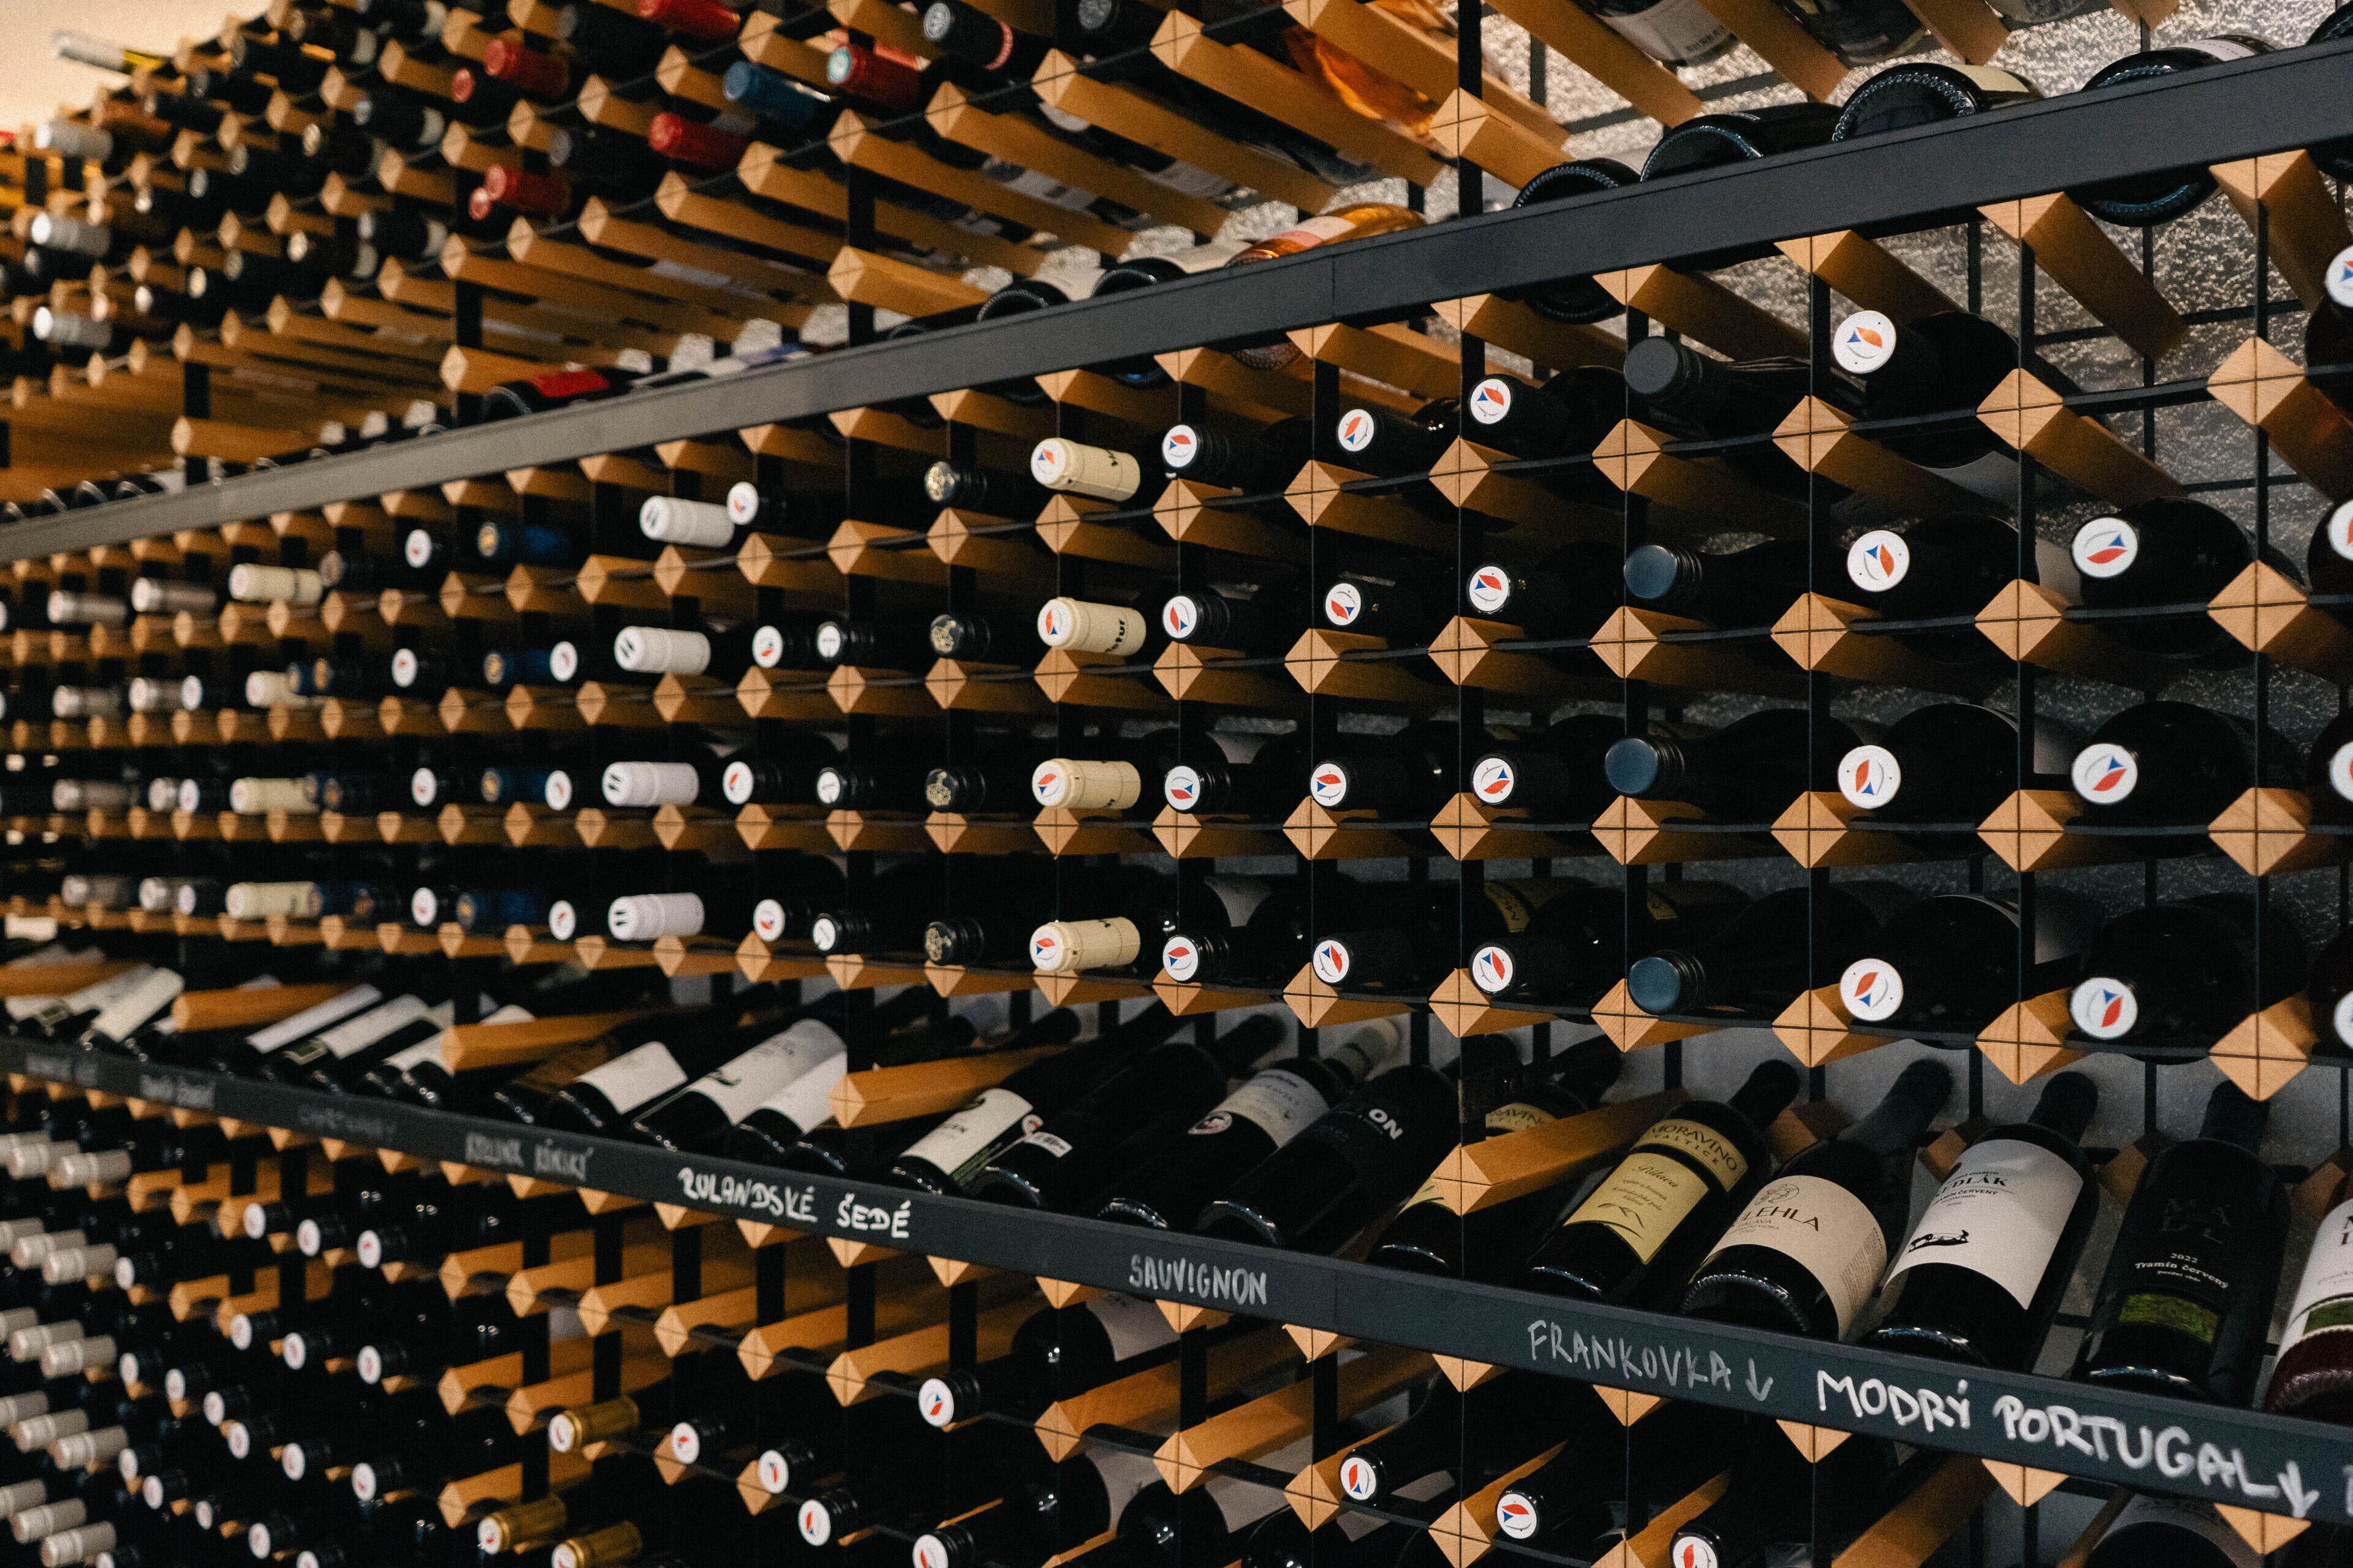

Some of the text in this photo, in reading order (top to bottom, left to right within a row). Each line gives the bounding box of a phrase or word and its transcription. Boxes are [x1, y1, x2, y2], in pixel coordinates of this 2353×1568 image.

[836, 1193, 911, 1239] ŠEDÉ
[1129, 1253, 1268, 1305] SAUVIGNON
[2135, 1261, 2229, 1289] Tramín červený
[2170, 1252, 2199, 1263] 2022
[1527, 1319, 1732, 1392] FRANKOVKA
[1816, 1370, 1971, 1433] MODRÝ
[1992, 1395, 2280, 1499] PORTUGAL
